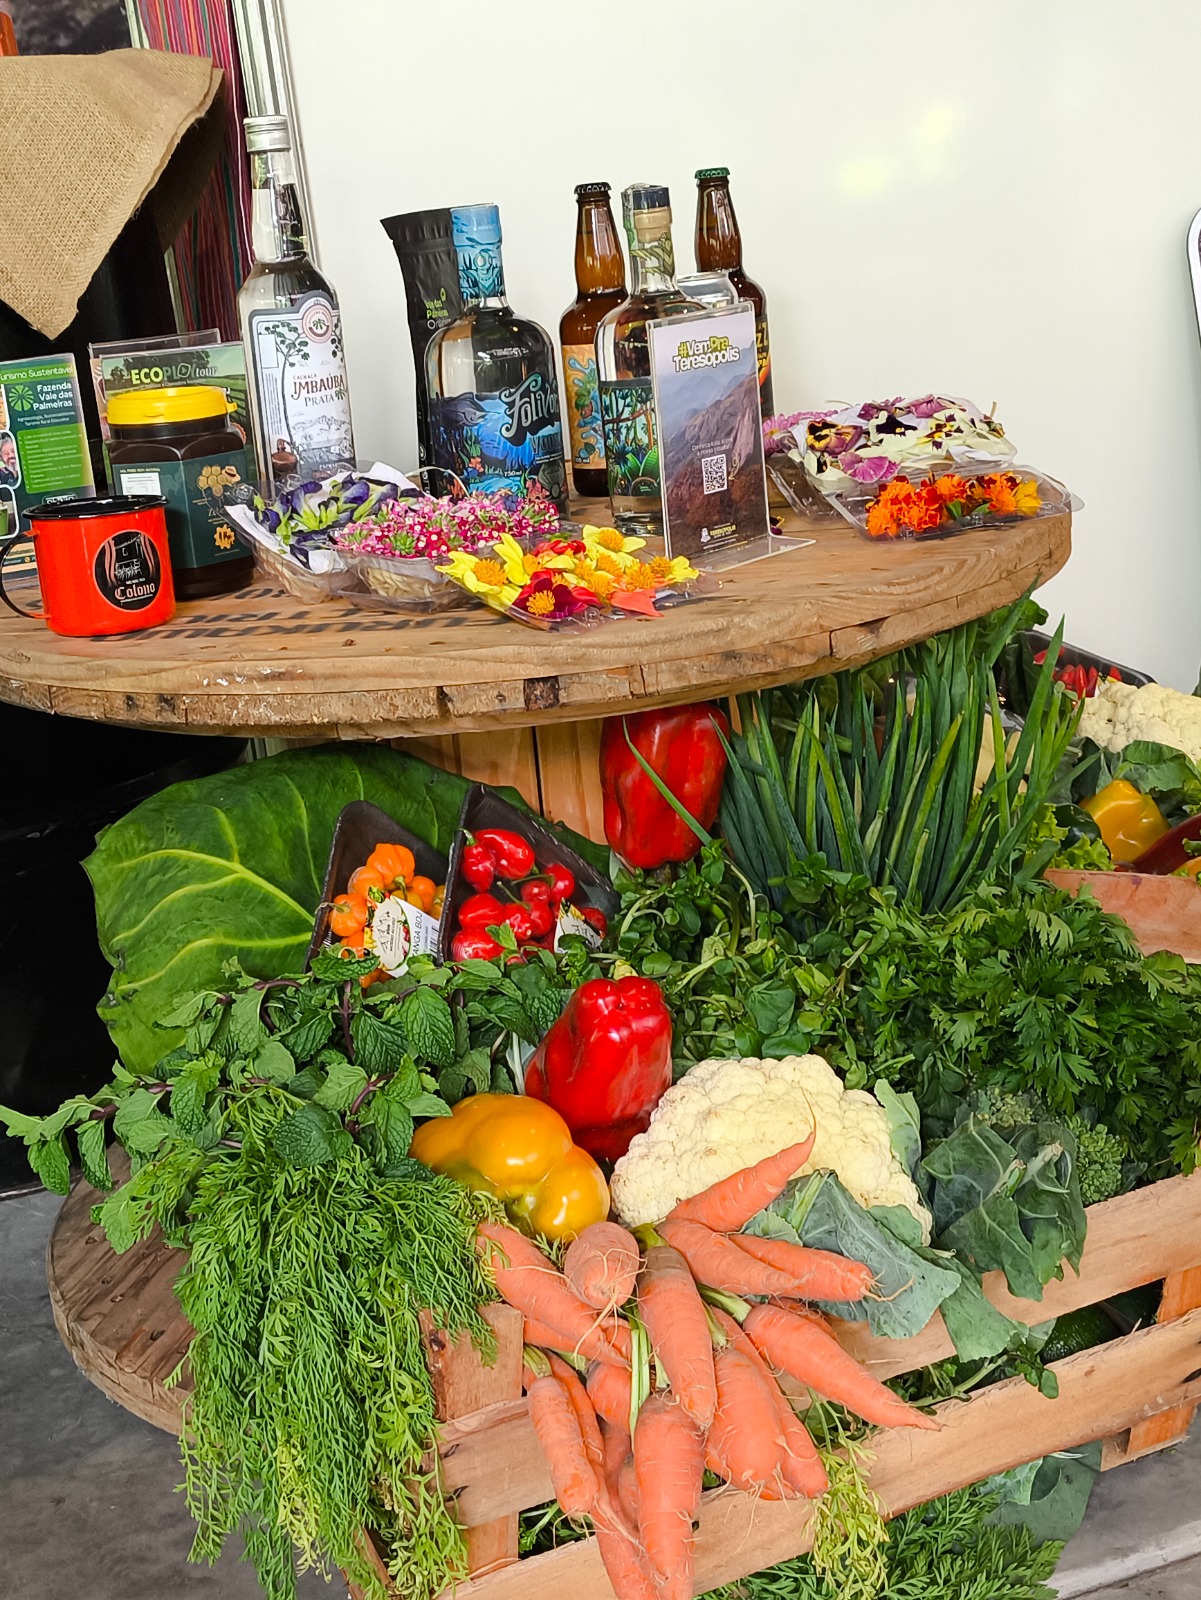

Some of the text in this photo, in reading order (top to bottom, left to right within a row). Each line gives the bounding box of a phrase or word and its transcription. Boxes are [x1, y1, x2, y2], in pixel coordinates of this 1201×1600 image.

[678, 336, 729, 357] #VemPra
[28, 365, 73, 378] Sustentável
[37, 381, 72, 393] Fazenda
[39, 391, 73, 401] Vale das
[304, 393, 335, 407] PRATA
[33, 400, 73, 411] Palmeiras
[115, 583, 156, 600] Colono
[91, 616, 510, 642] FURUKAWA
[415, 911, 423, 929] BDJ
